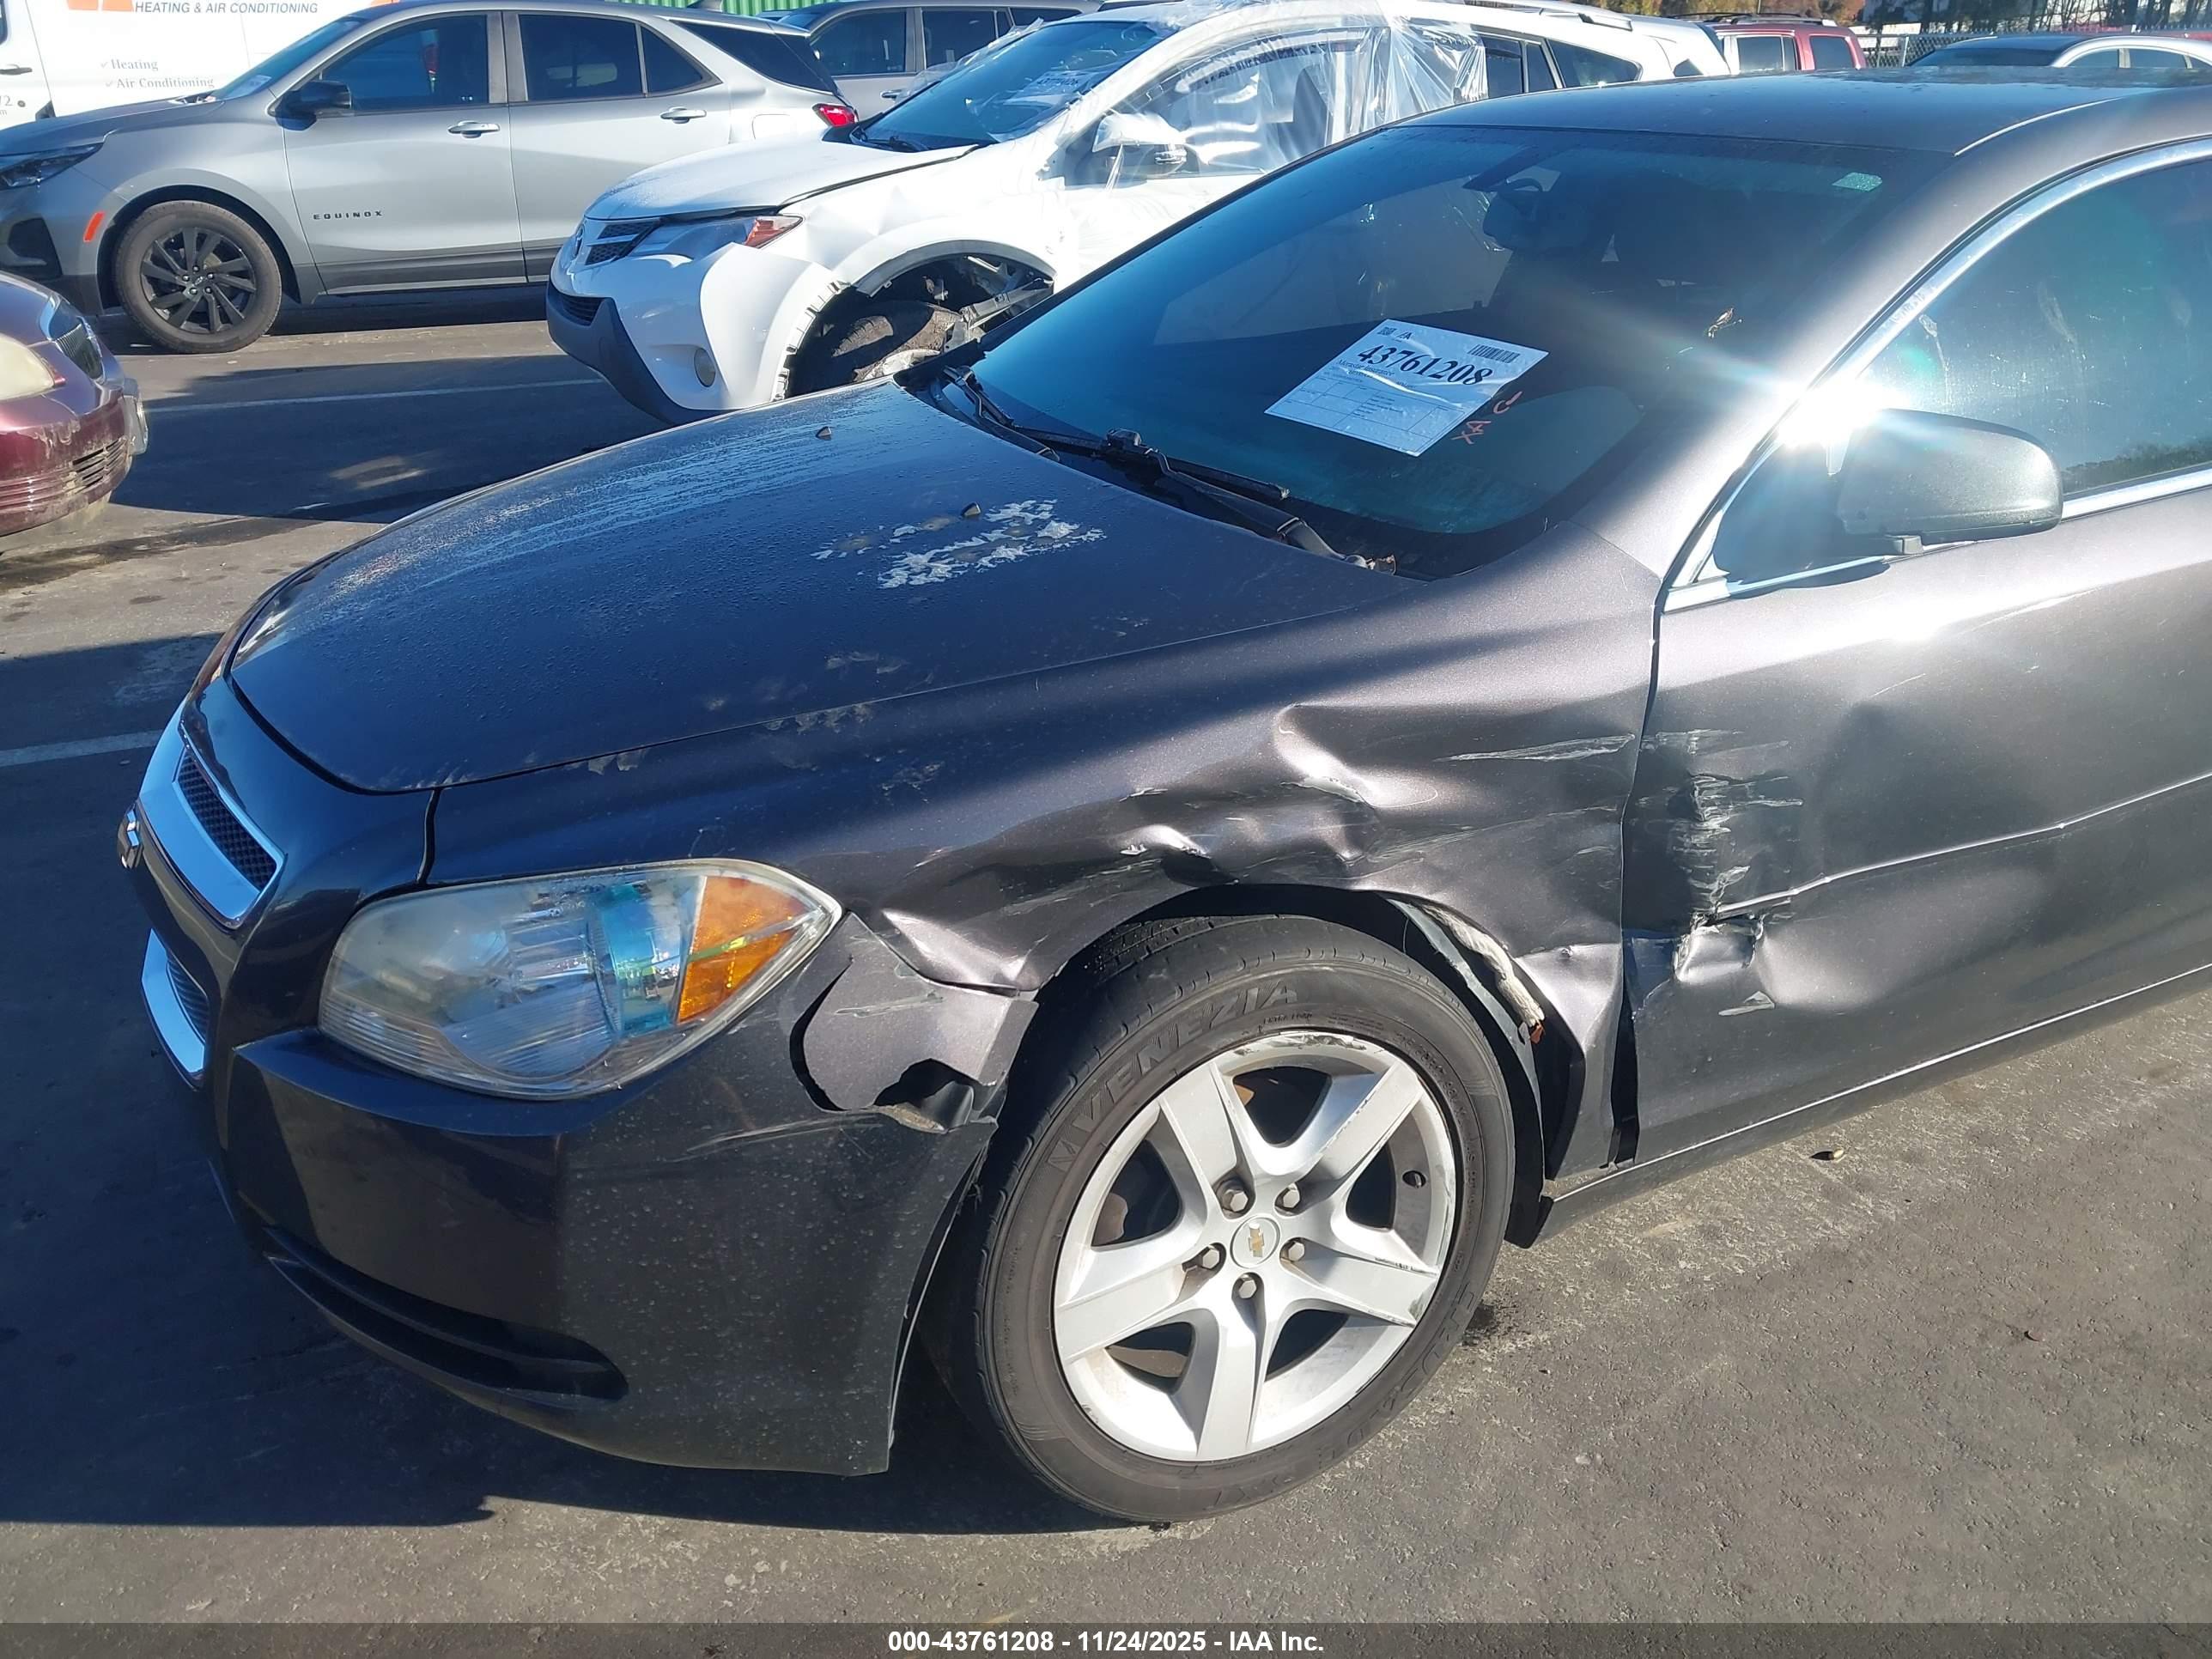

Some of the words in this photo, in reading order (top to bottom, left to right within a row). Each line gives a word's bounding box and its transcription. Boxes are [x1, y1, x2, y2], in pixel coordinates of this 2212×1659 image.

[135, 2, 191, 14] HEATING
[194, 2, 202, 14] &
[205, 3, 227, 14] AIR
[229, 2, 319, 15] CONDITIONING
[111, 58, 159, 72] Heating
[115, 77, 136, 89] Air
[137, 76, 215, 89] Conditioning
[313, 210, 383, 221] EQUINOX
[1358, 344, 1493, 386] 43761208
